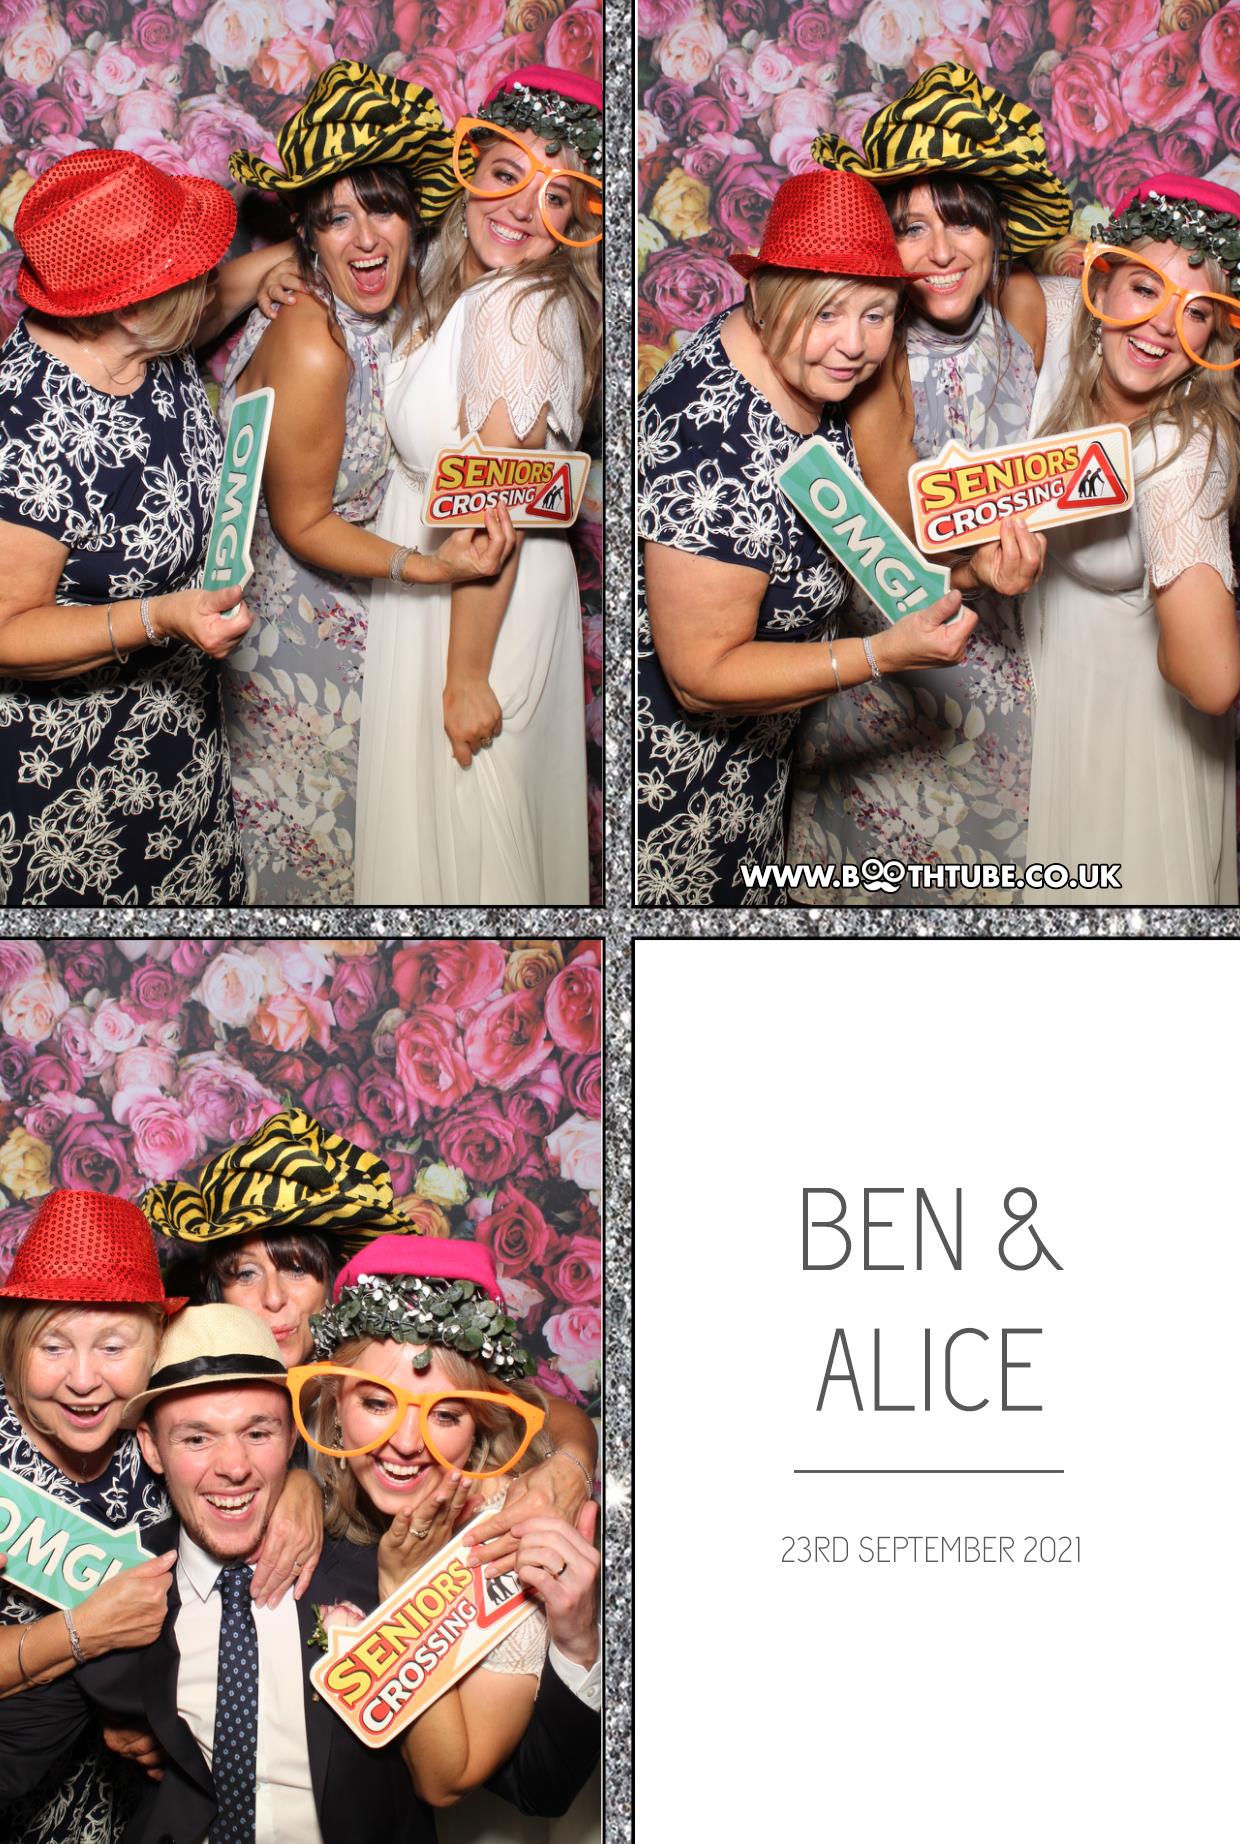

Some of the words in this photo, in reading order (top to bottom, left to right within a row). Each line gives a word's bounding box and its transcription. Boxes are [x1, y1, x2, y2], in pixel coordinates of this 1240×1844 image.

[211, 424, 254, 581] OMG!
[432, 487, 537, 520] CROSSING
[438, 456, 554, 490] SENIORS
[920, 446, 1080, 511] SENIORS
[926, 479, 1065, 543] CROSSING
[808, 477, 930, 612] OMG!
[326, 1560, 473, 1708] SENIORS
[361, 1598, 477, 1733] CROSSING
